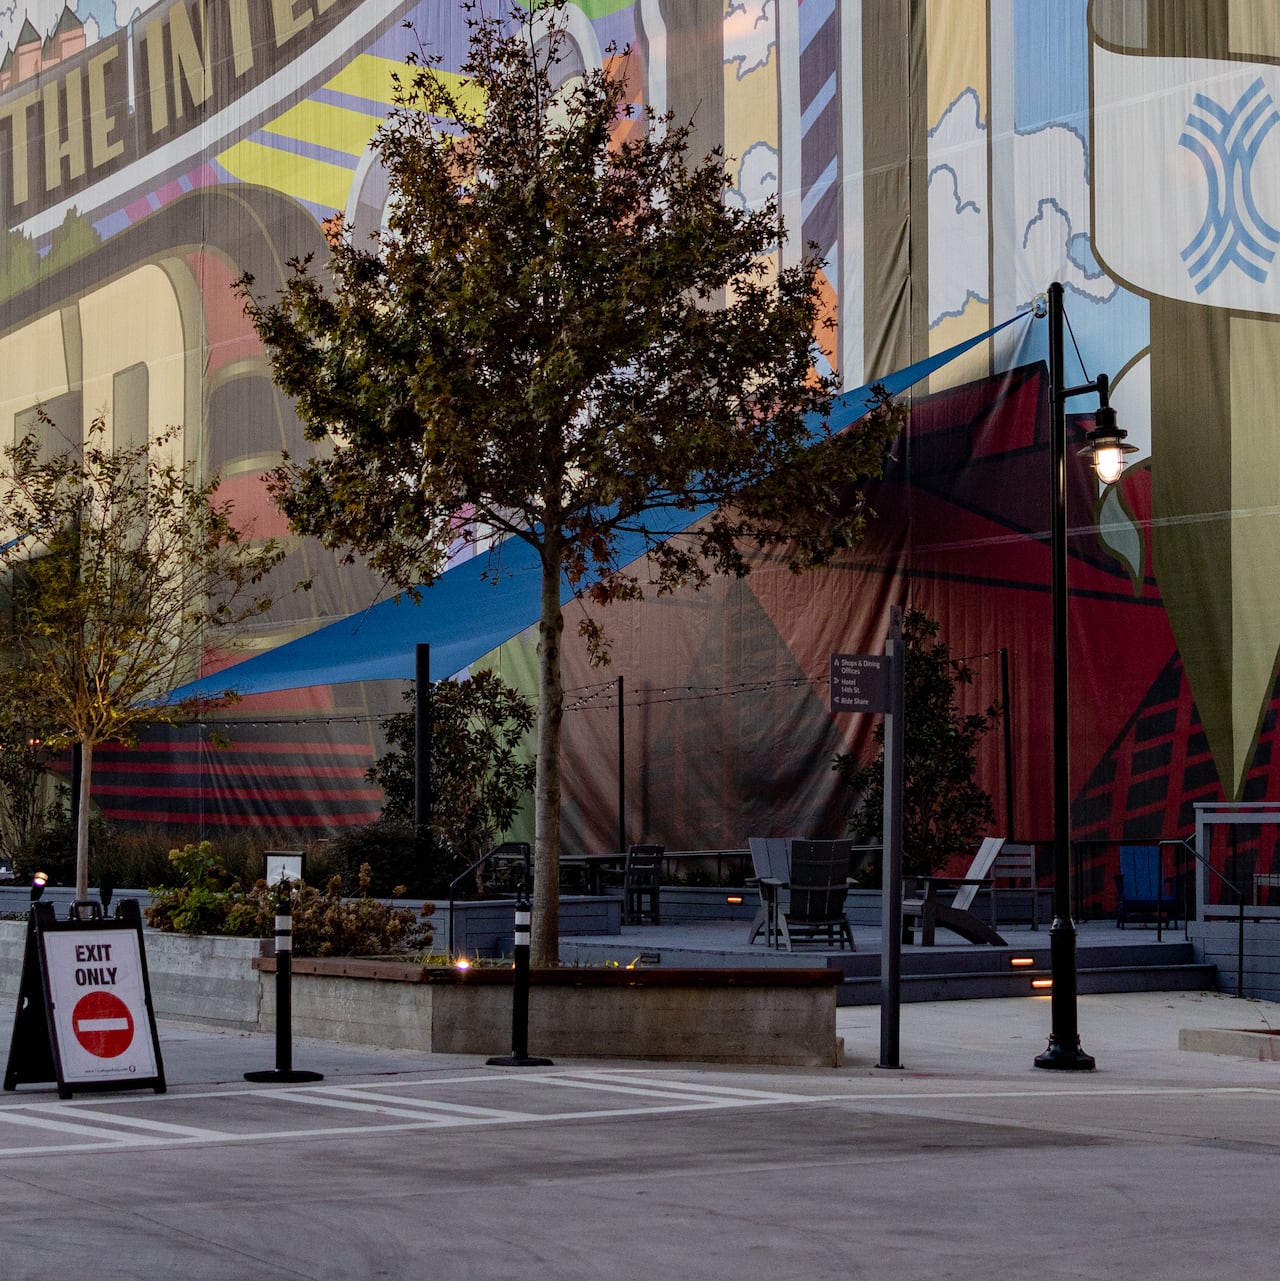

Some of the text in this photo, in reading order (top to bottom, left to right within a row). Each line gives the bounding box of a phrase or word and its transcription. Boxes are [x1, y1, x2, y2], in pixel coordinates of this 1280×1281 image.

[841, 659, 858, 668] Shops
[863, 660, 881, 669] Dining
[841, 667, 861, 675] Offices
[840, 697, 869, 706] Ride Share
[75, 944, 112, 963] EXIT
[75, 966, 118, 986] ONLY
